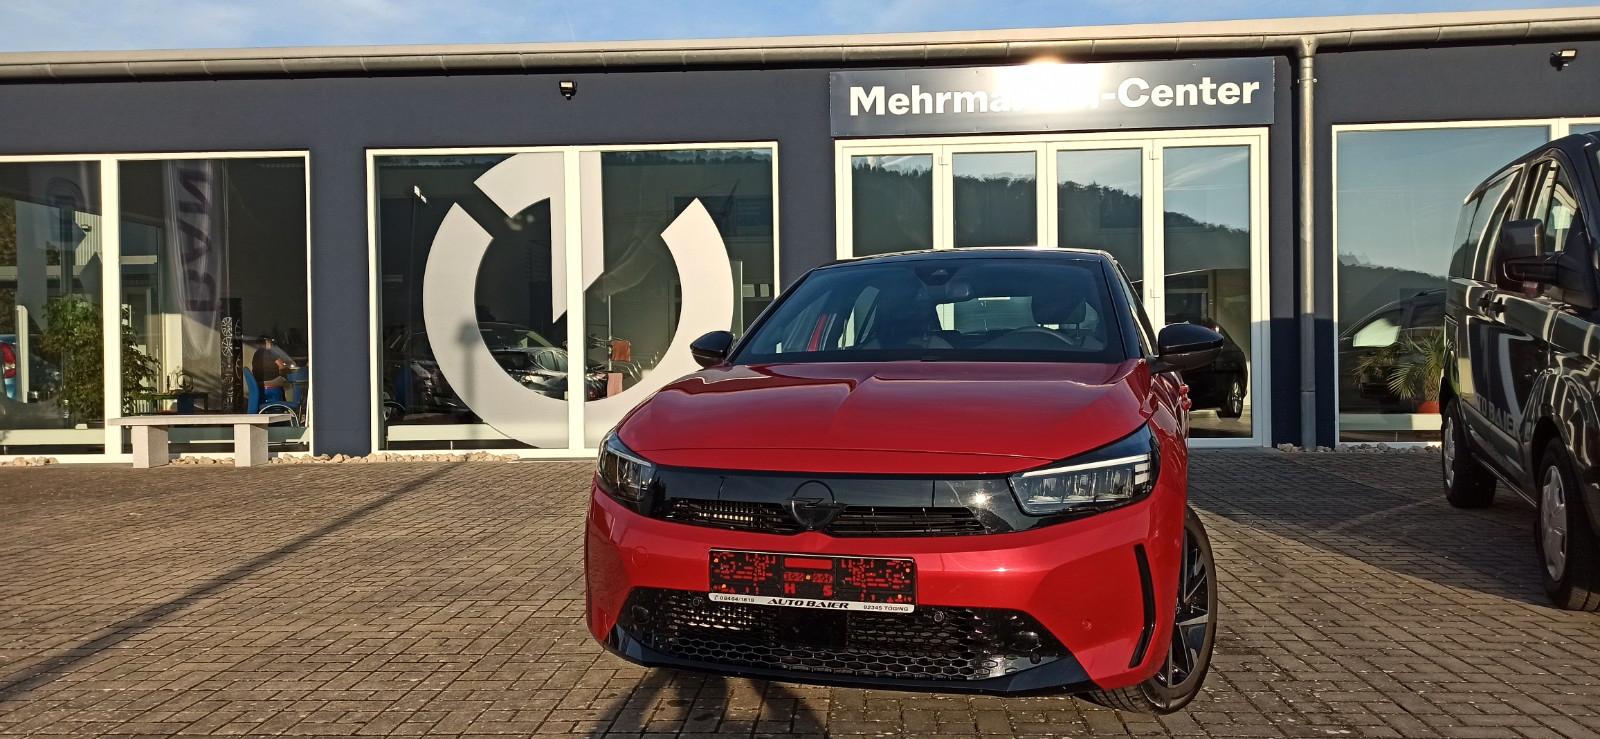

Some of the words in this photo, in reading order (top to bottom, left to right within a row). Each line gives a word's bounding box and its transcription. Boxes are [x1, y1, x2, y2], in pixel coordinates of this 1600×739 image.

[848, 76, 1260, 117] Mehrma-Center
[768, 598, 804, 606] AUTO
[806, 600, 849, 609] BAIER
